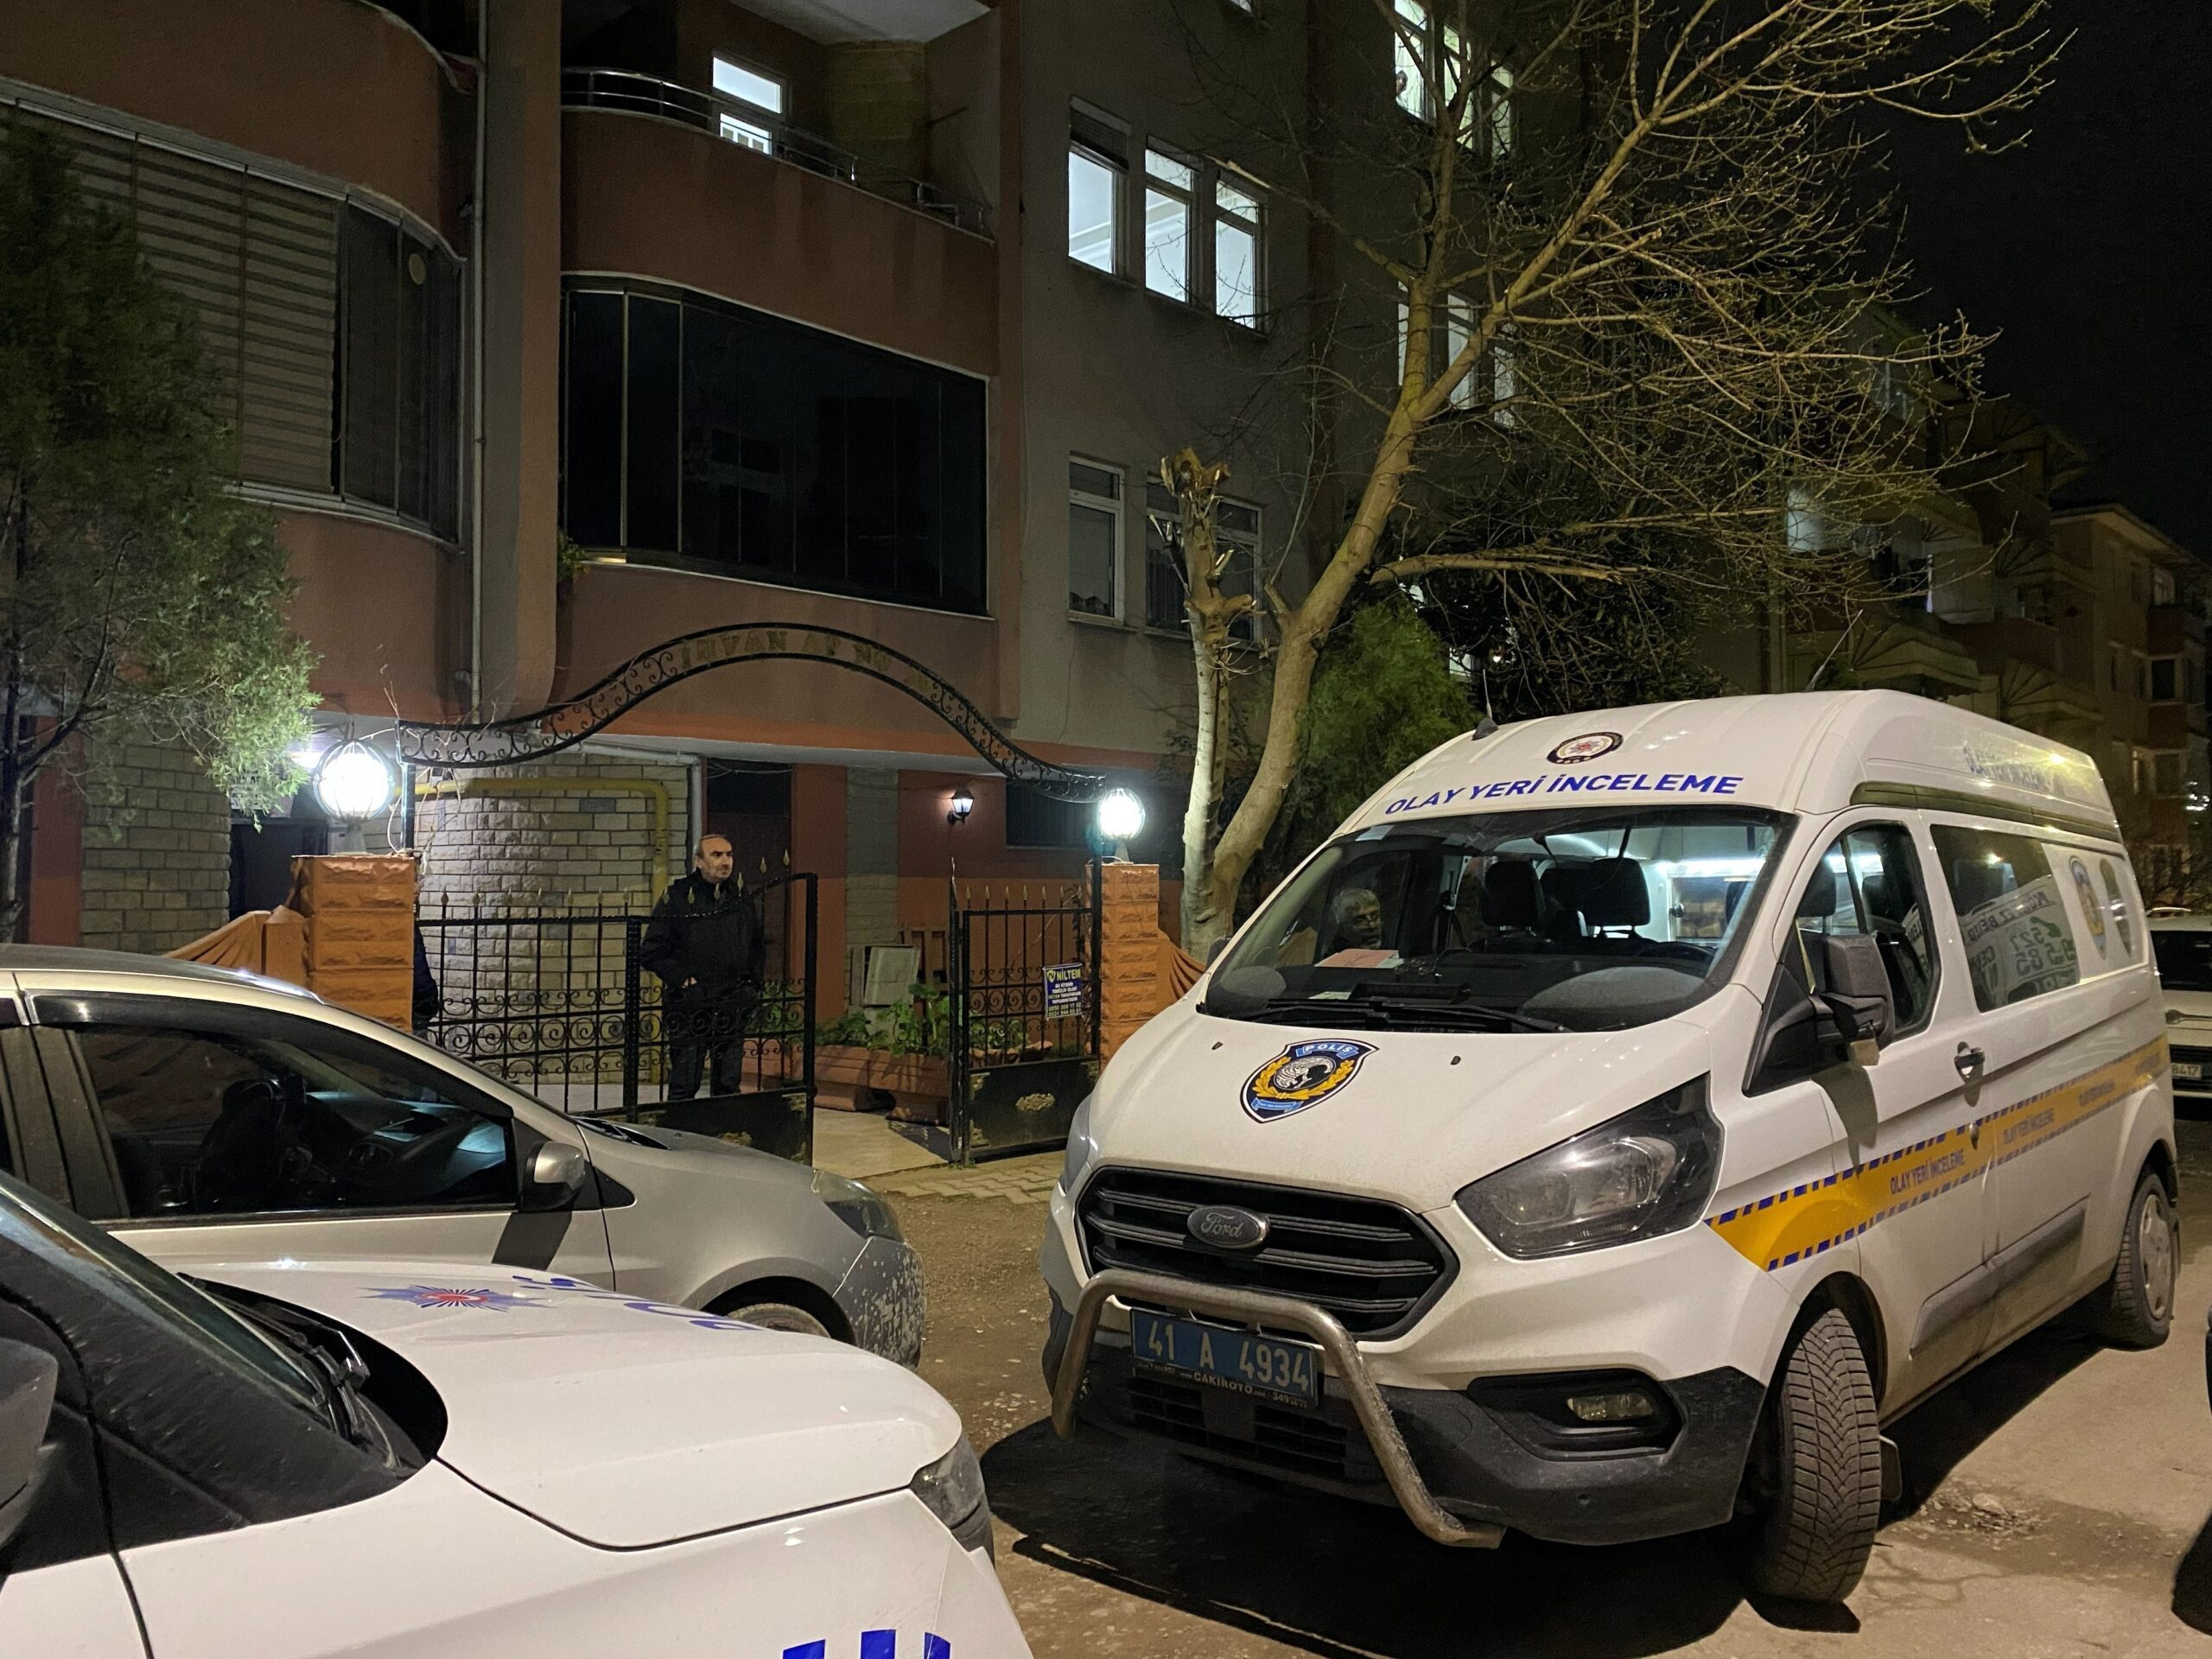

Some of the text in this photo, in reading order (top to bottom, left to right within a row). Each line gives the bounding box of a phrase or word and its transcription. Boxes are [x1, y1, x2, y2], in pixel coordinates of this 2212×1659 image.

[1385, 772, 1744, 815] OLAY YERİ İNCELEME
[1305, 1044, 1352, 1053] POLİS
[1891, 1170, 1910, 1195] OLAY
[1200, 1213, 1242, 1237] Ford
[1148, 1320, 1308, 1391] 41 A 4934
